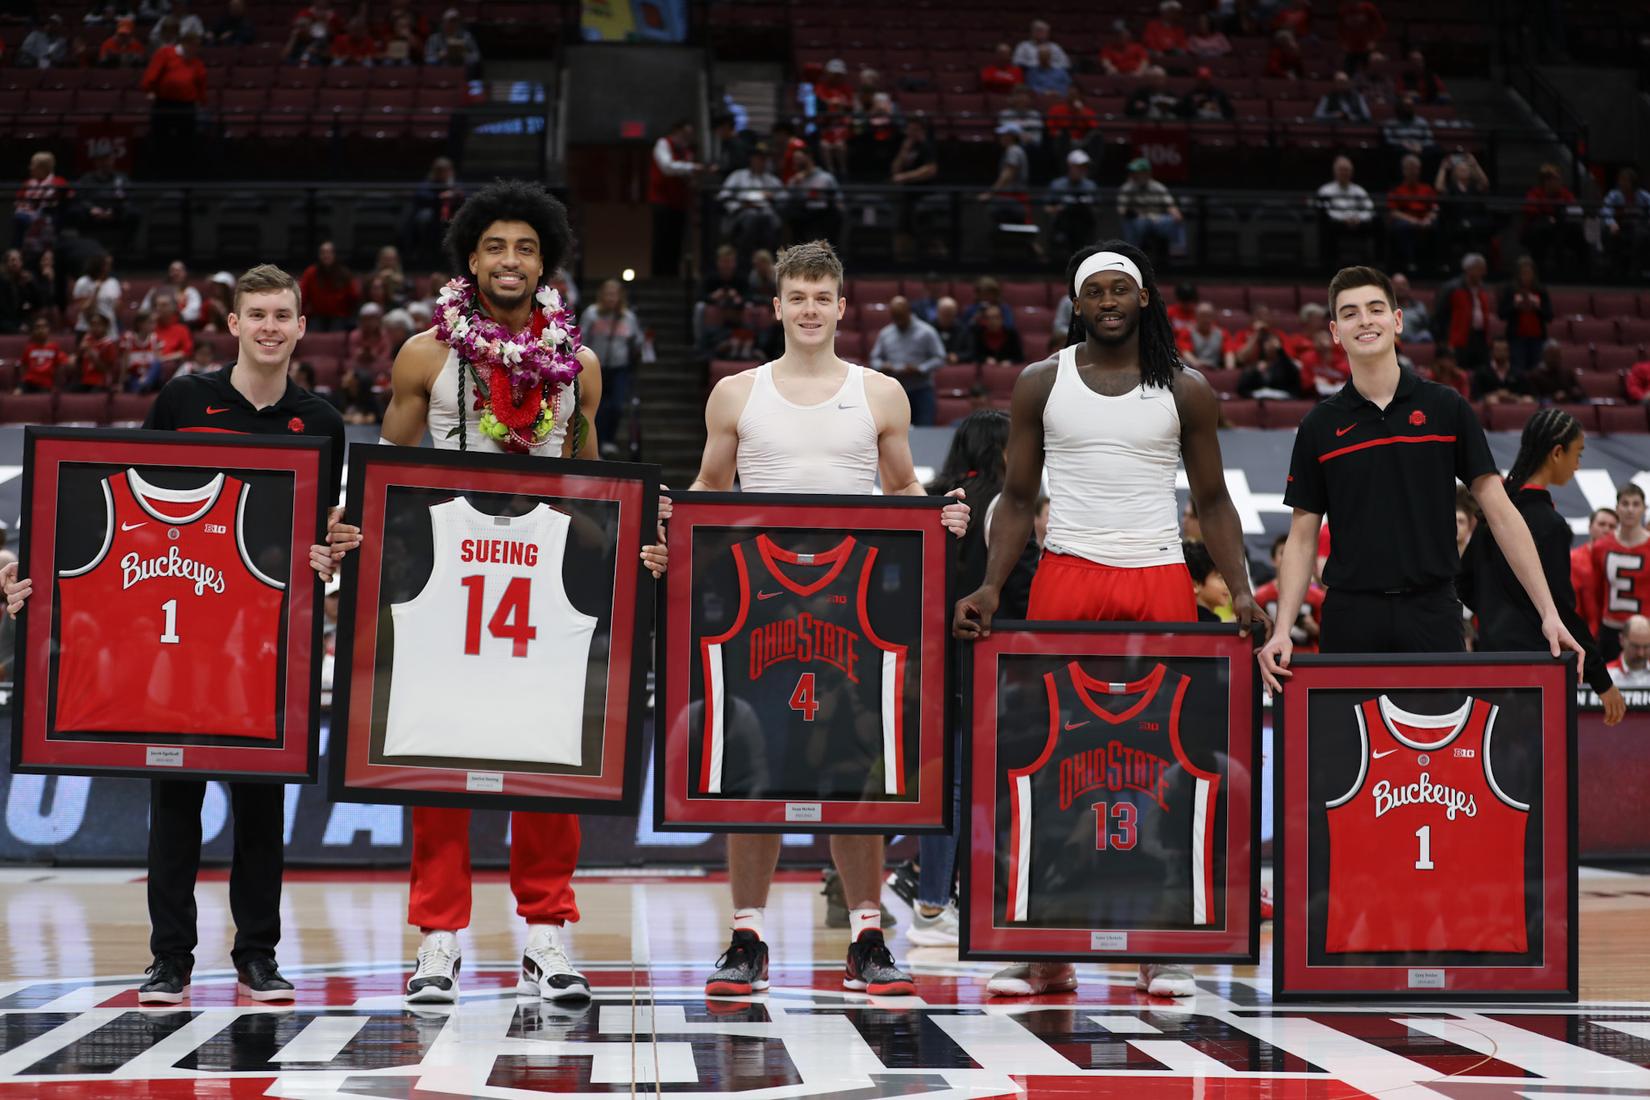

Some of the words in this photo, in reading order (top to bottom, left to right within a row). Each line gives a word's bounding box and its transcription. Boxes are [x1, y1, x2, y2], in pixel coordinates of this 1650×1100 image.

[120, 545, 226, 596] Buckeyes
[460, 539, 539, 568] SUEING
[1606, 553, 1641, 612] E
[159, 598, 180, 644] 1
[460, 574, 537, 659] 14
[788, 672, 820, 722] 4
[1372, 772, 1478, 821] Buckeyes
[1091, 801, 1138, 851] 13
[1414, 825, 1435, 870] 1
